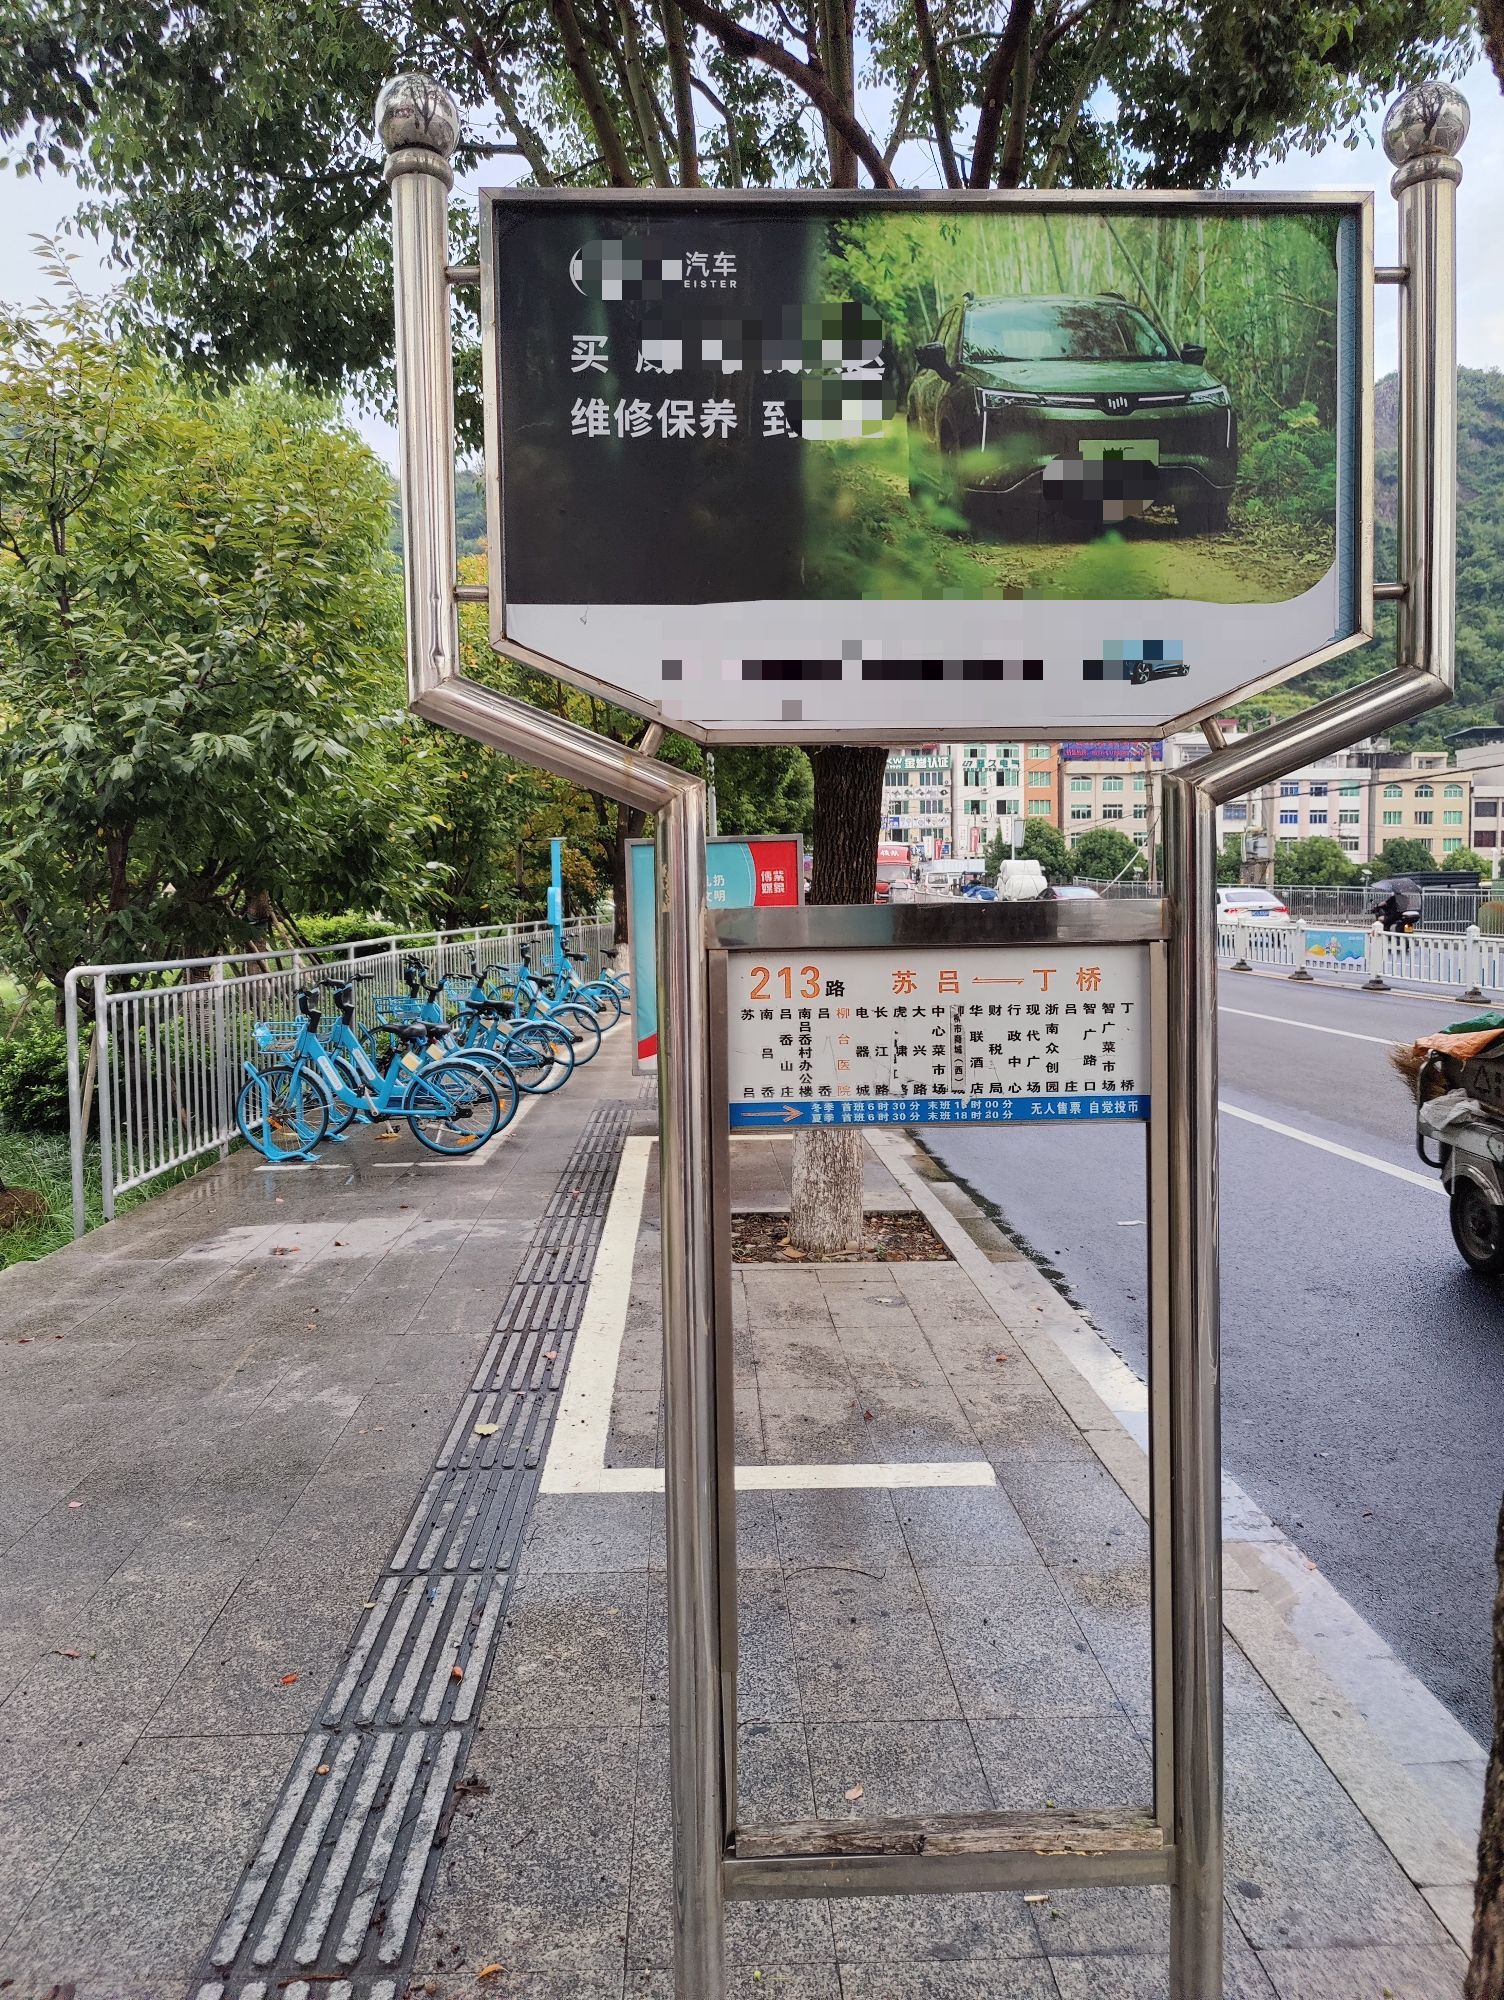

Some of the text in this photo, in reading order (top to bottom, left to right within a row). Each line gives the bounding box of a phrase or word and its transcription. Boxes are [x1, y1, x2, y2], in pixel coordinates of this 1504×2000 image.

[685, 251, 737, 277] 汽车
[571, 335, 609, 373] 买
[571, 398, 738, 438] 维修保养
[750, 965, 1102, 1000] 213路 苏吕 丁桥
[741, 1008, 755, 1098] 苏吕
[836, 1007, 851, 1096] 柳台医院
[856, 1007, 870, 1096] 电器城
[874, 1006, 889, 1096] 长江路
[913, 1006, 927, 1095] 大兴路
[932, 1006, 946, 1095] 中心菜市场
[970, 1005, 984, 1094] 华联酒店
[989, 1005, 1003, 1094] 财税局
[1008, 1004, 1021, 1093] 行政中心
[1026, 1004, 1040, 1093] 现代广场
[1045, 1004, 1059, 1092] 浙南众创园
[1065, 1004, 1078, 1092] 吕庄
[1083, 1003, 1097, 1091] 智广路口
[1102, 1003, 1115, 1091] 智广菜市场
[1121, 1002, 1135, 1091] 丁桥
[1031, 1100, 1138, 1115] 无人售票 自觉投币
